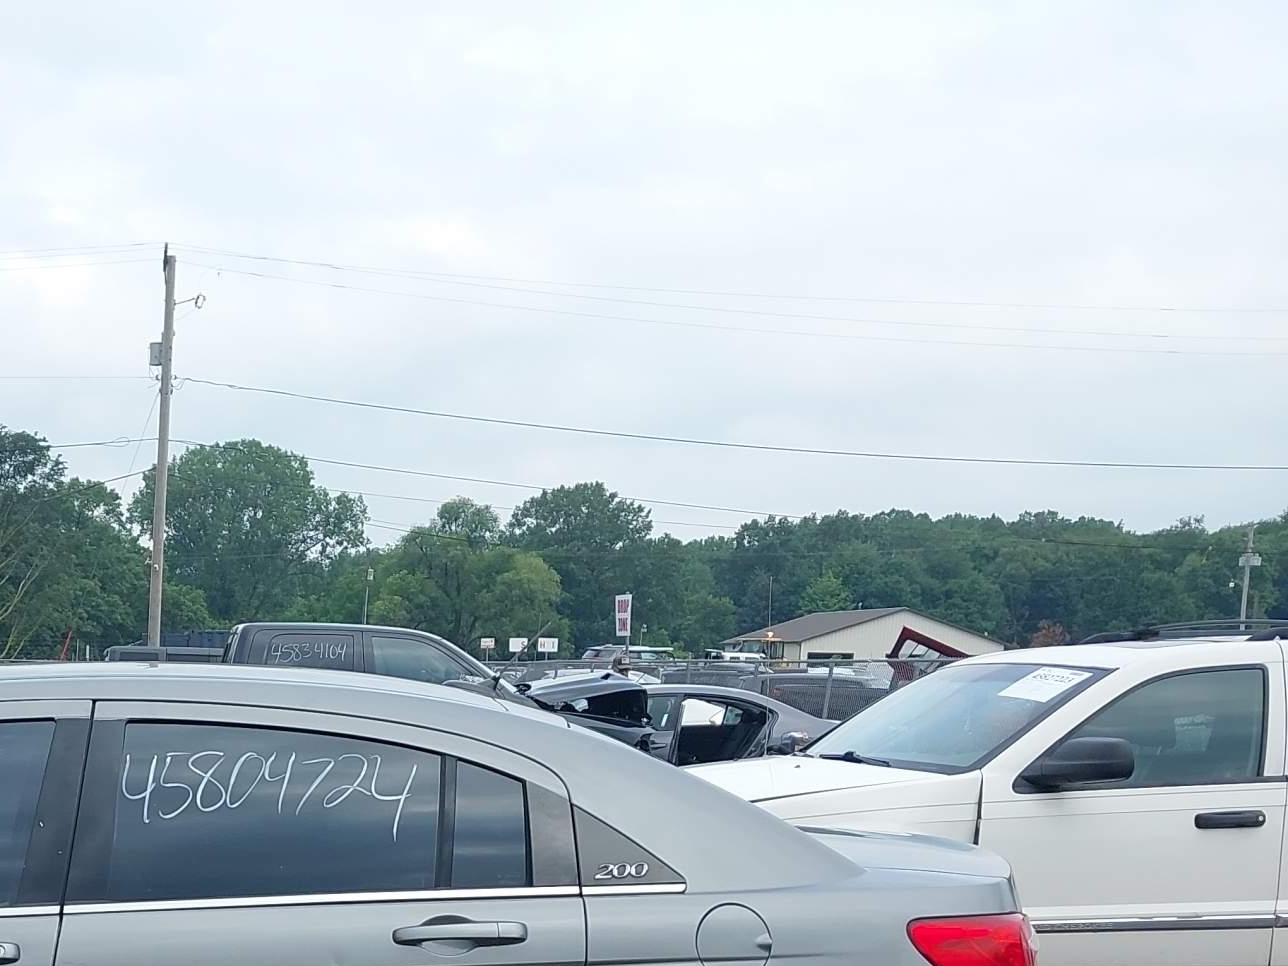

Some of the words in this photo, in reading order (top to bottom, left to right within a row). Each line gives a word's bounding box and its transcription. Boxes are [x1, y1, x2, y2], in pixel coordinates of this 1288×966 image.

[271, 642, 347, 664] 45834104
[122, 750, 418, 843] 45804724
[594, 862, 649, 880] 200
